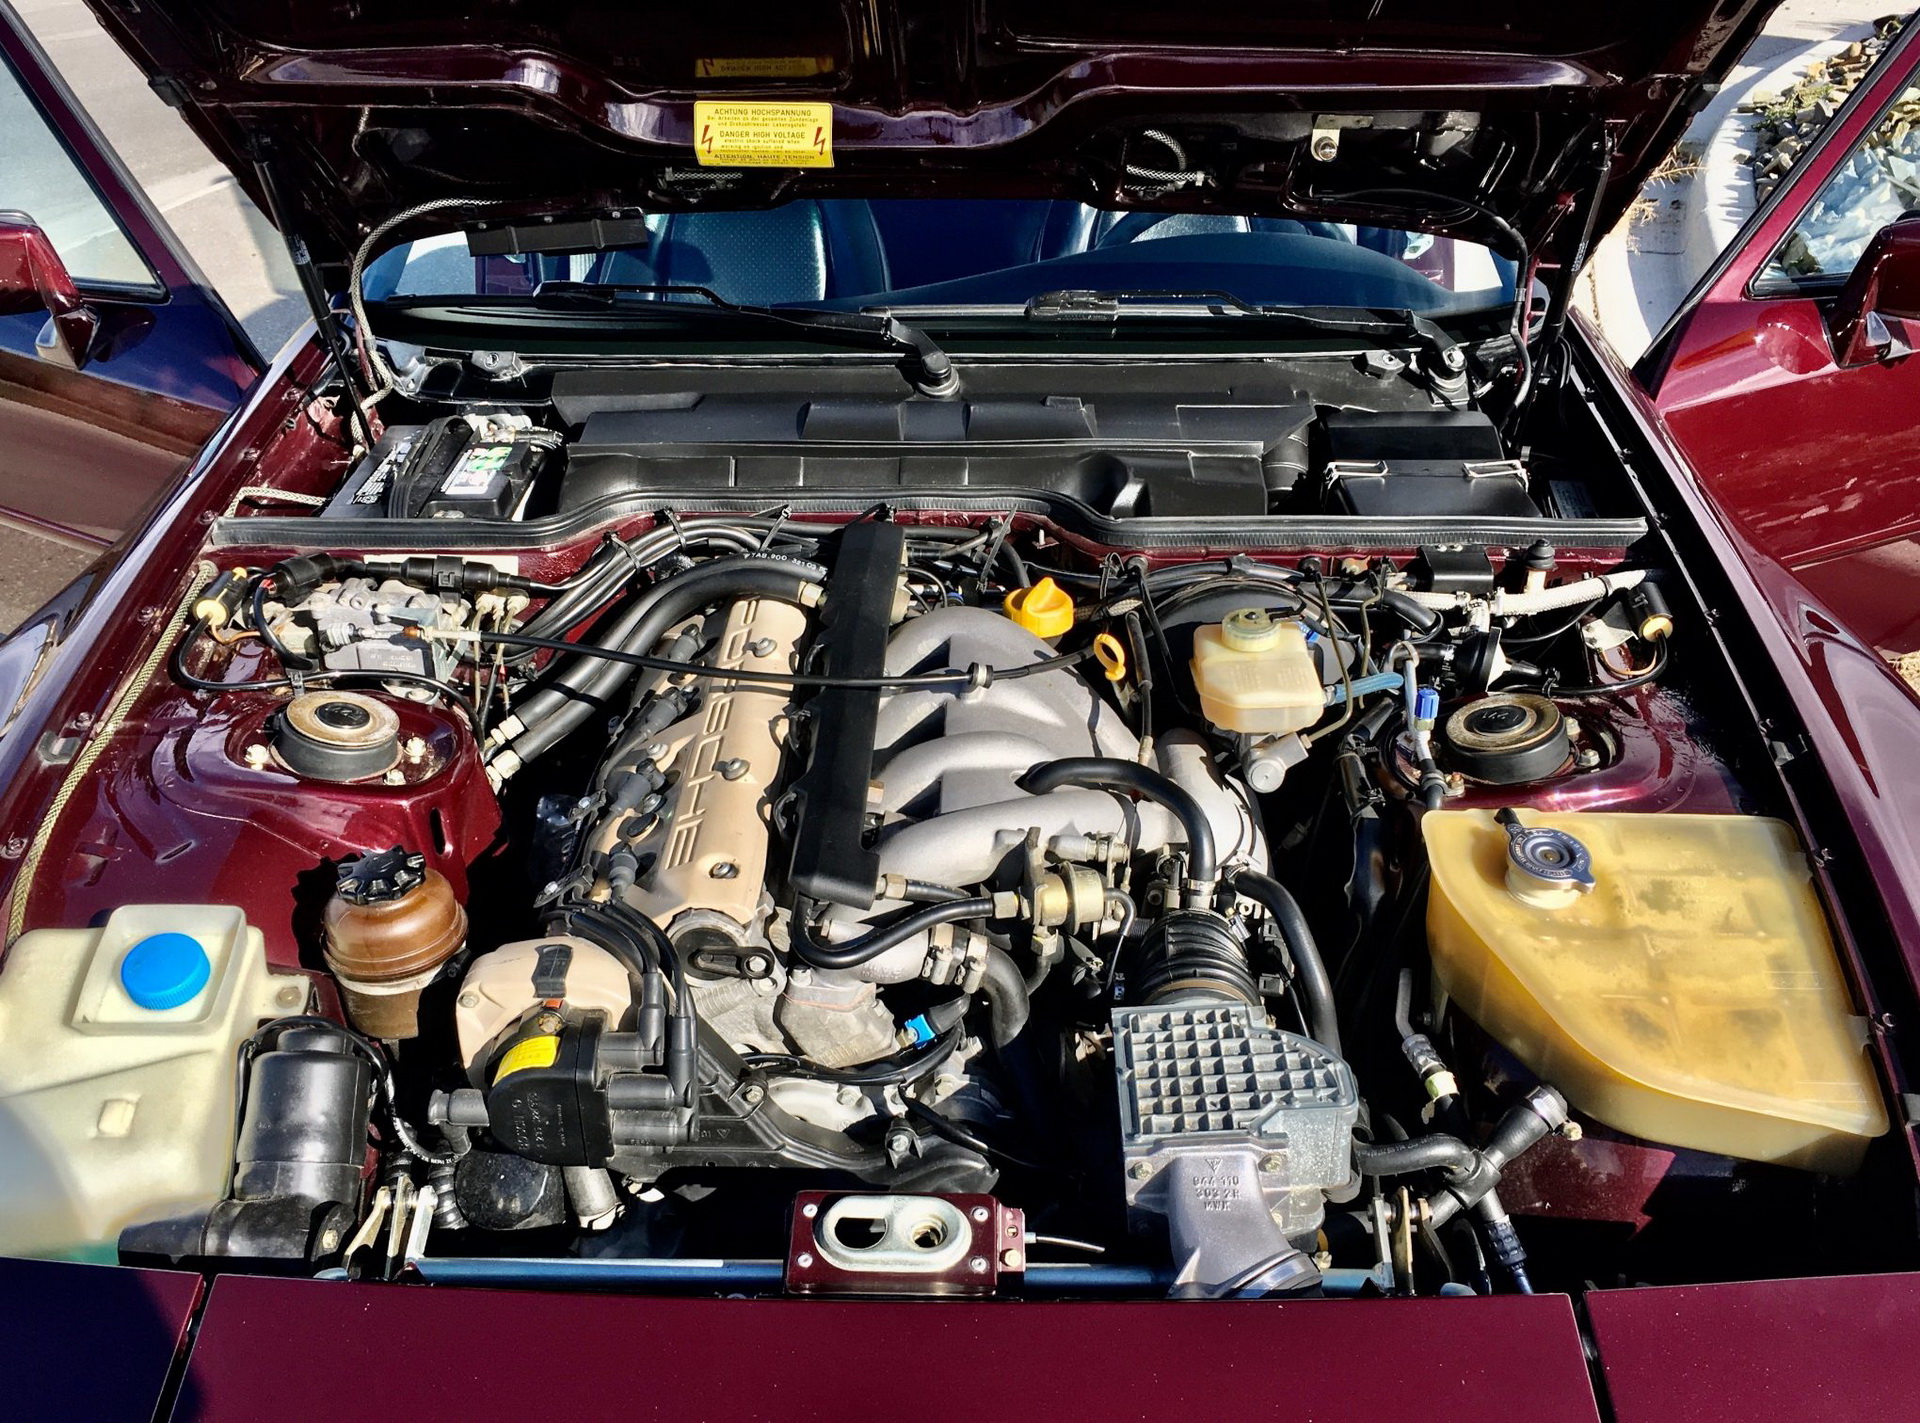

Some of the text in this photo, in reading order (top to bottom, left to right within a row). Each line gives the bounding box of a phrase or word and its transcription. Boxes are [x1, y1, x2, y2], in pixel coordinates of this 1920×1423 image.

[664, 597, 759, 869] PORSCHE
[1192, 1176, 1239, 1187] 944 110
